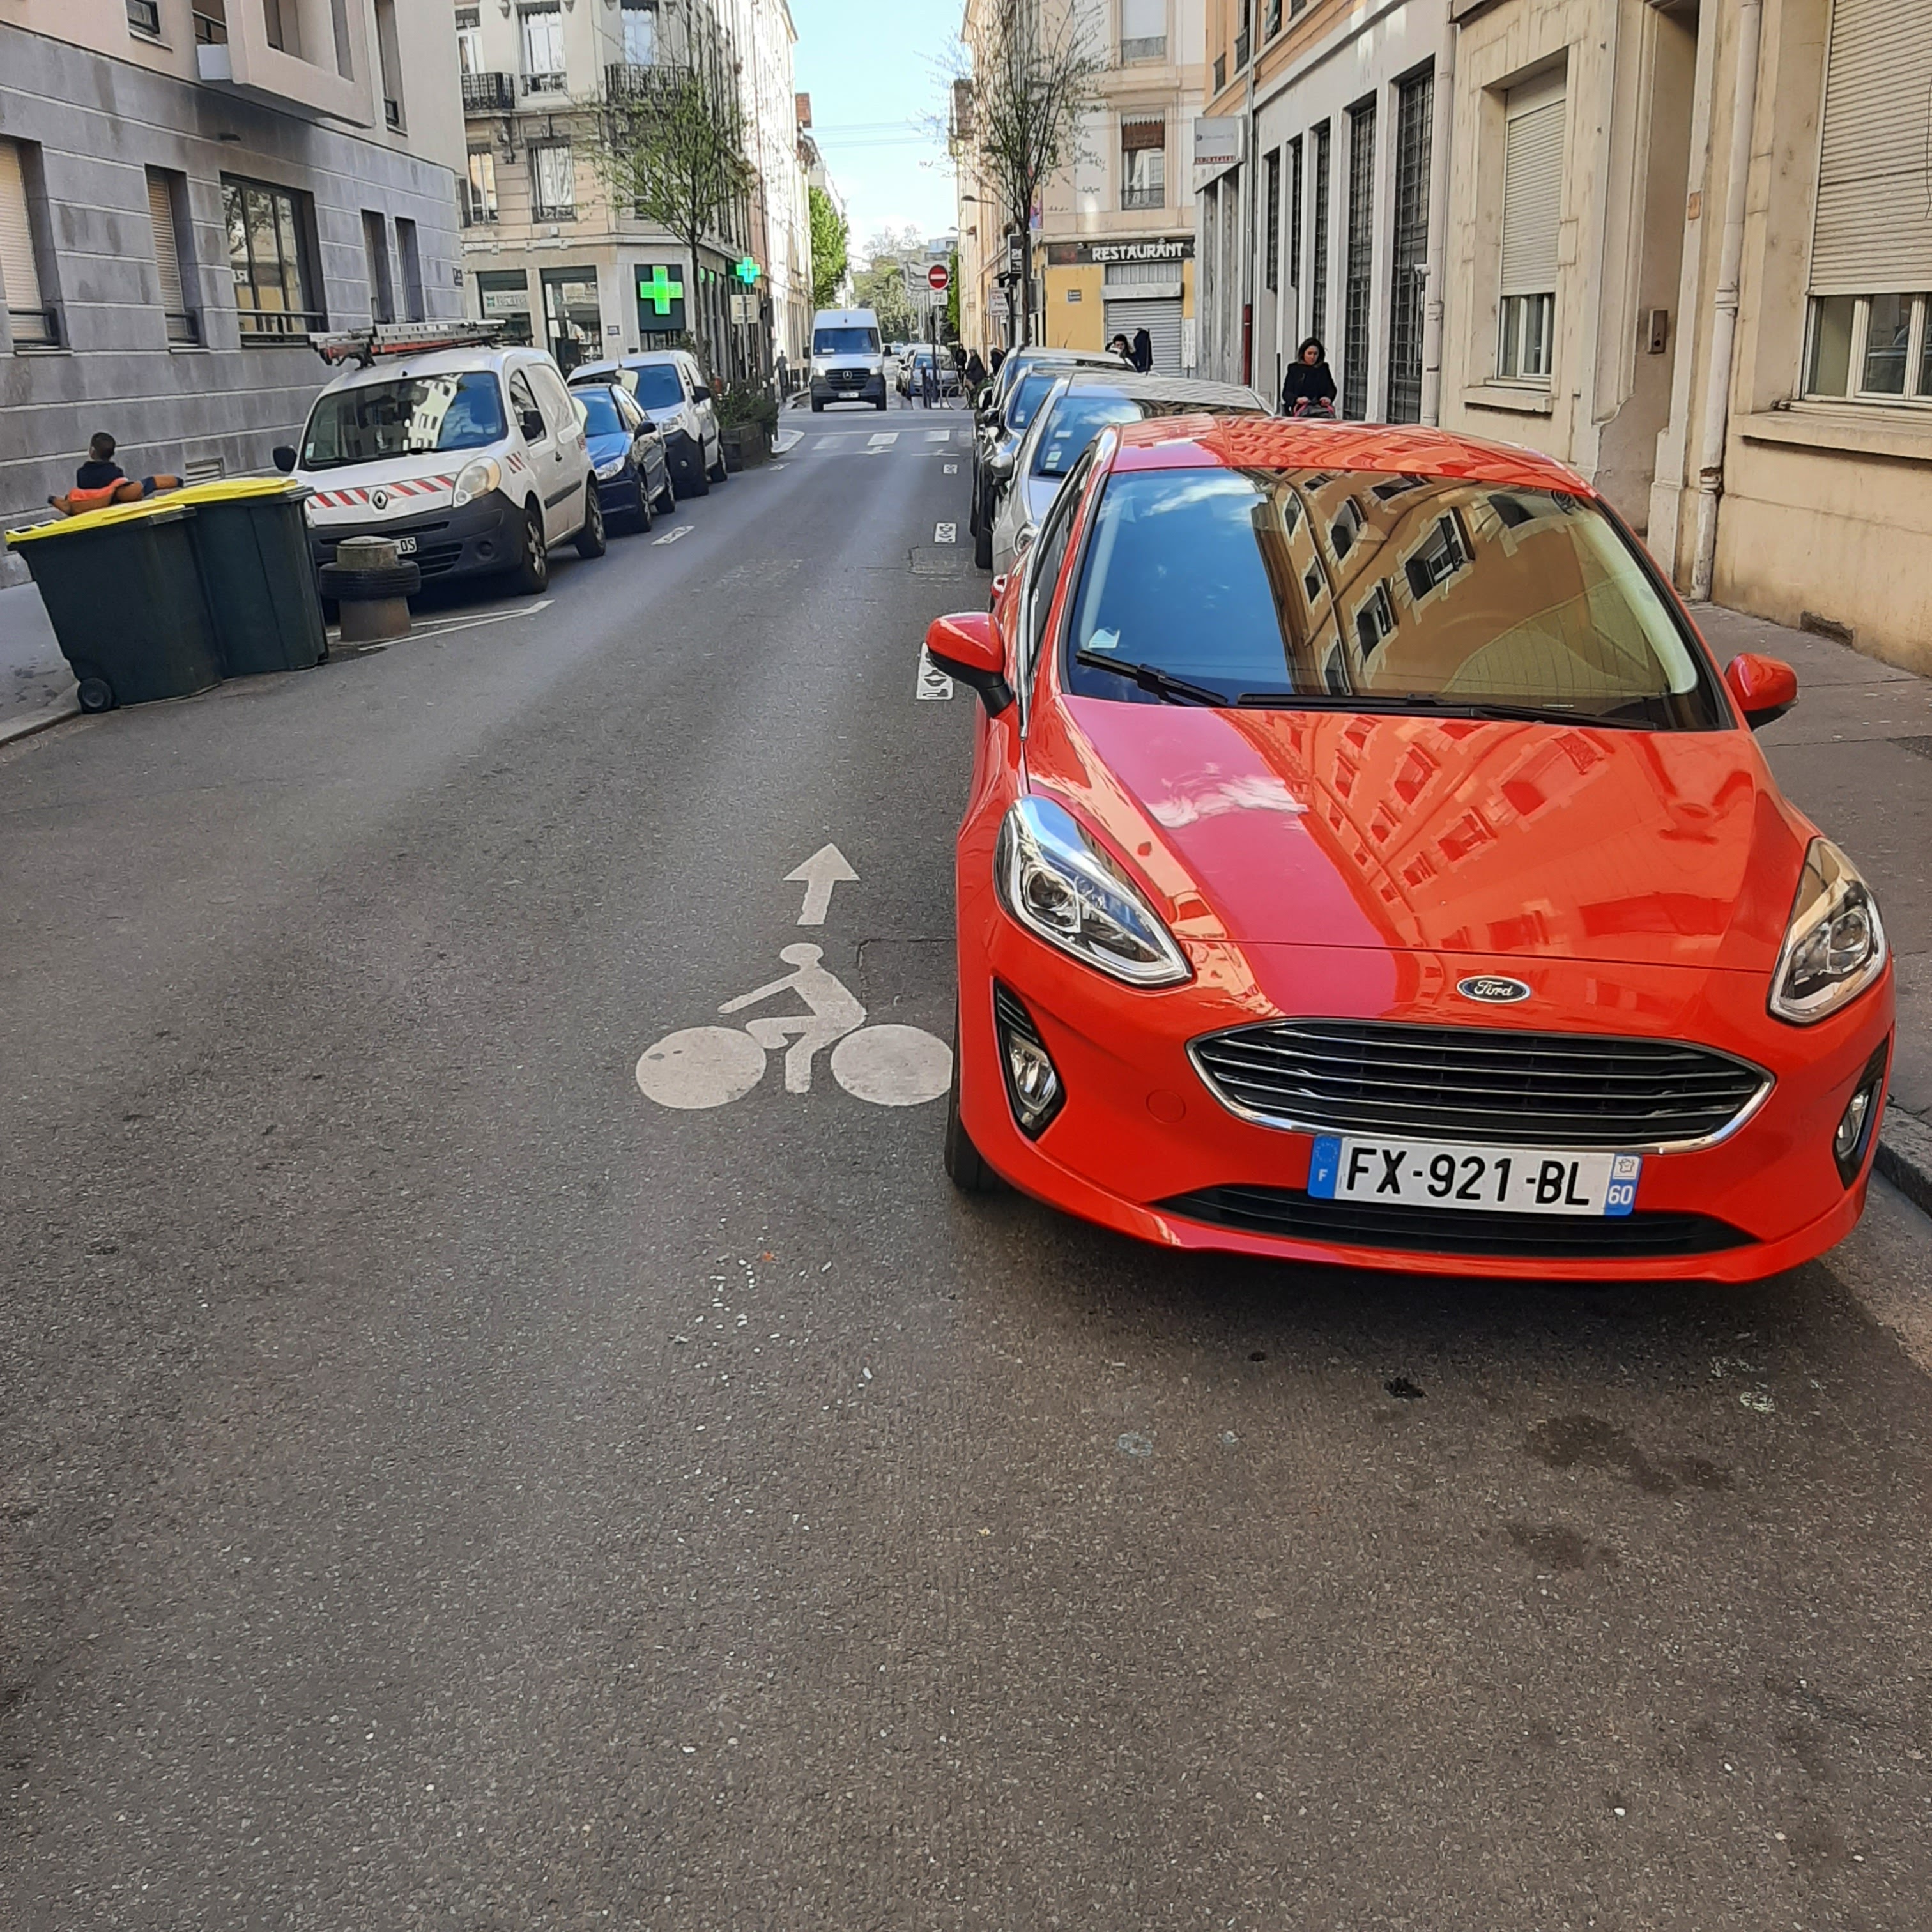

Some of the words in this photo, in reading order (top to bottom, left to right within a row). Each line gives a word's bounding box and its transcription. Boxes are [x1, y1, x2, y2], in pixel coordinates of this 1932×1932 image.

[1092, 243, 1183, 261] RESTAURANT
[1474, 980, 1514, 996] Ford
[1318, 1169, 1328, 1181] F
[1347, 1147, 1589, 1206] FX-921-BL
[1608, 1184, 1634, 1205] 60
